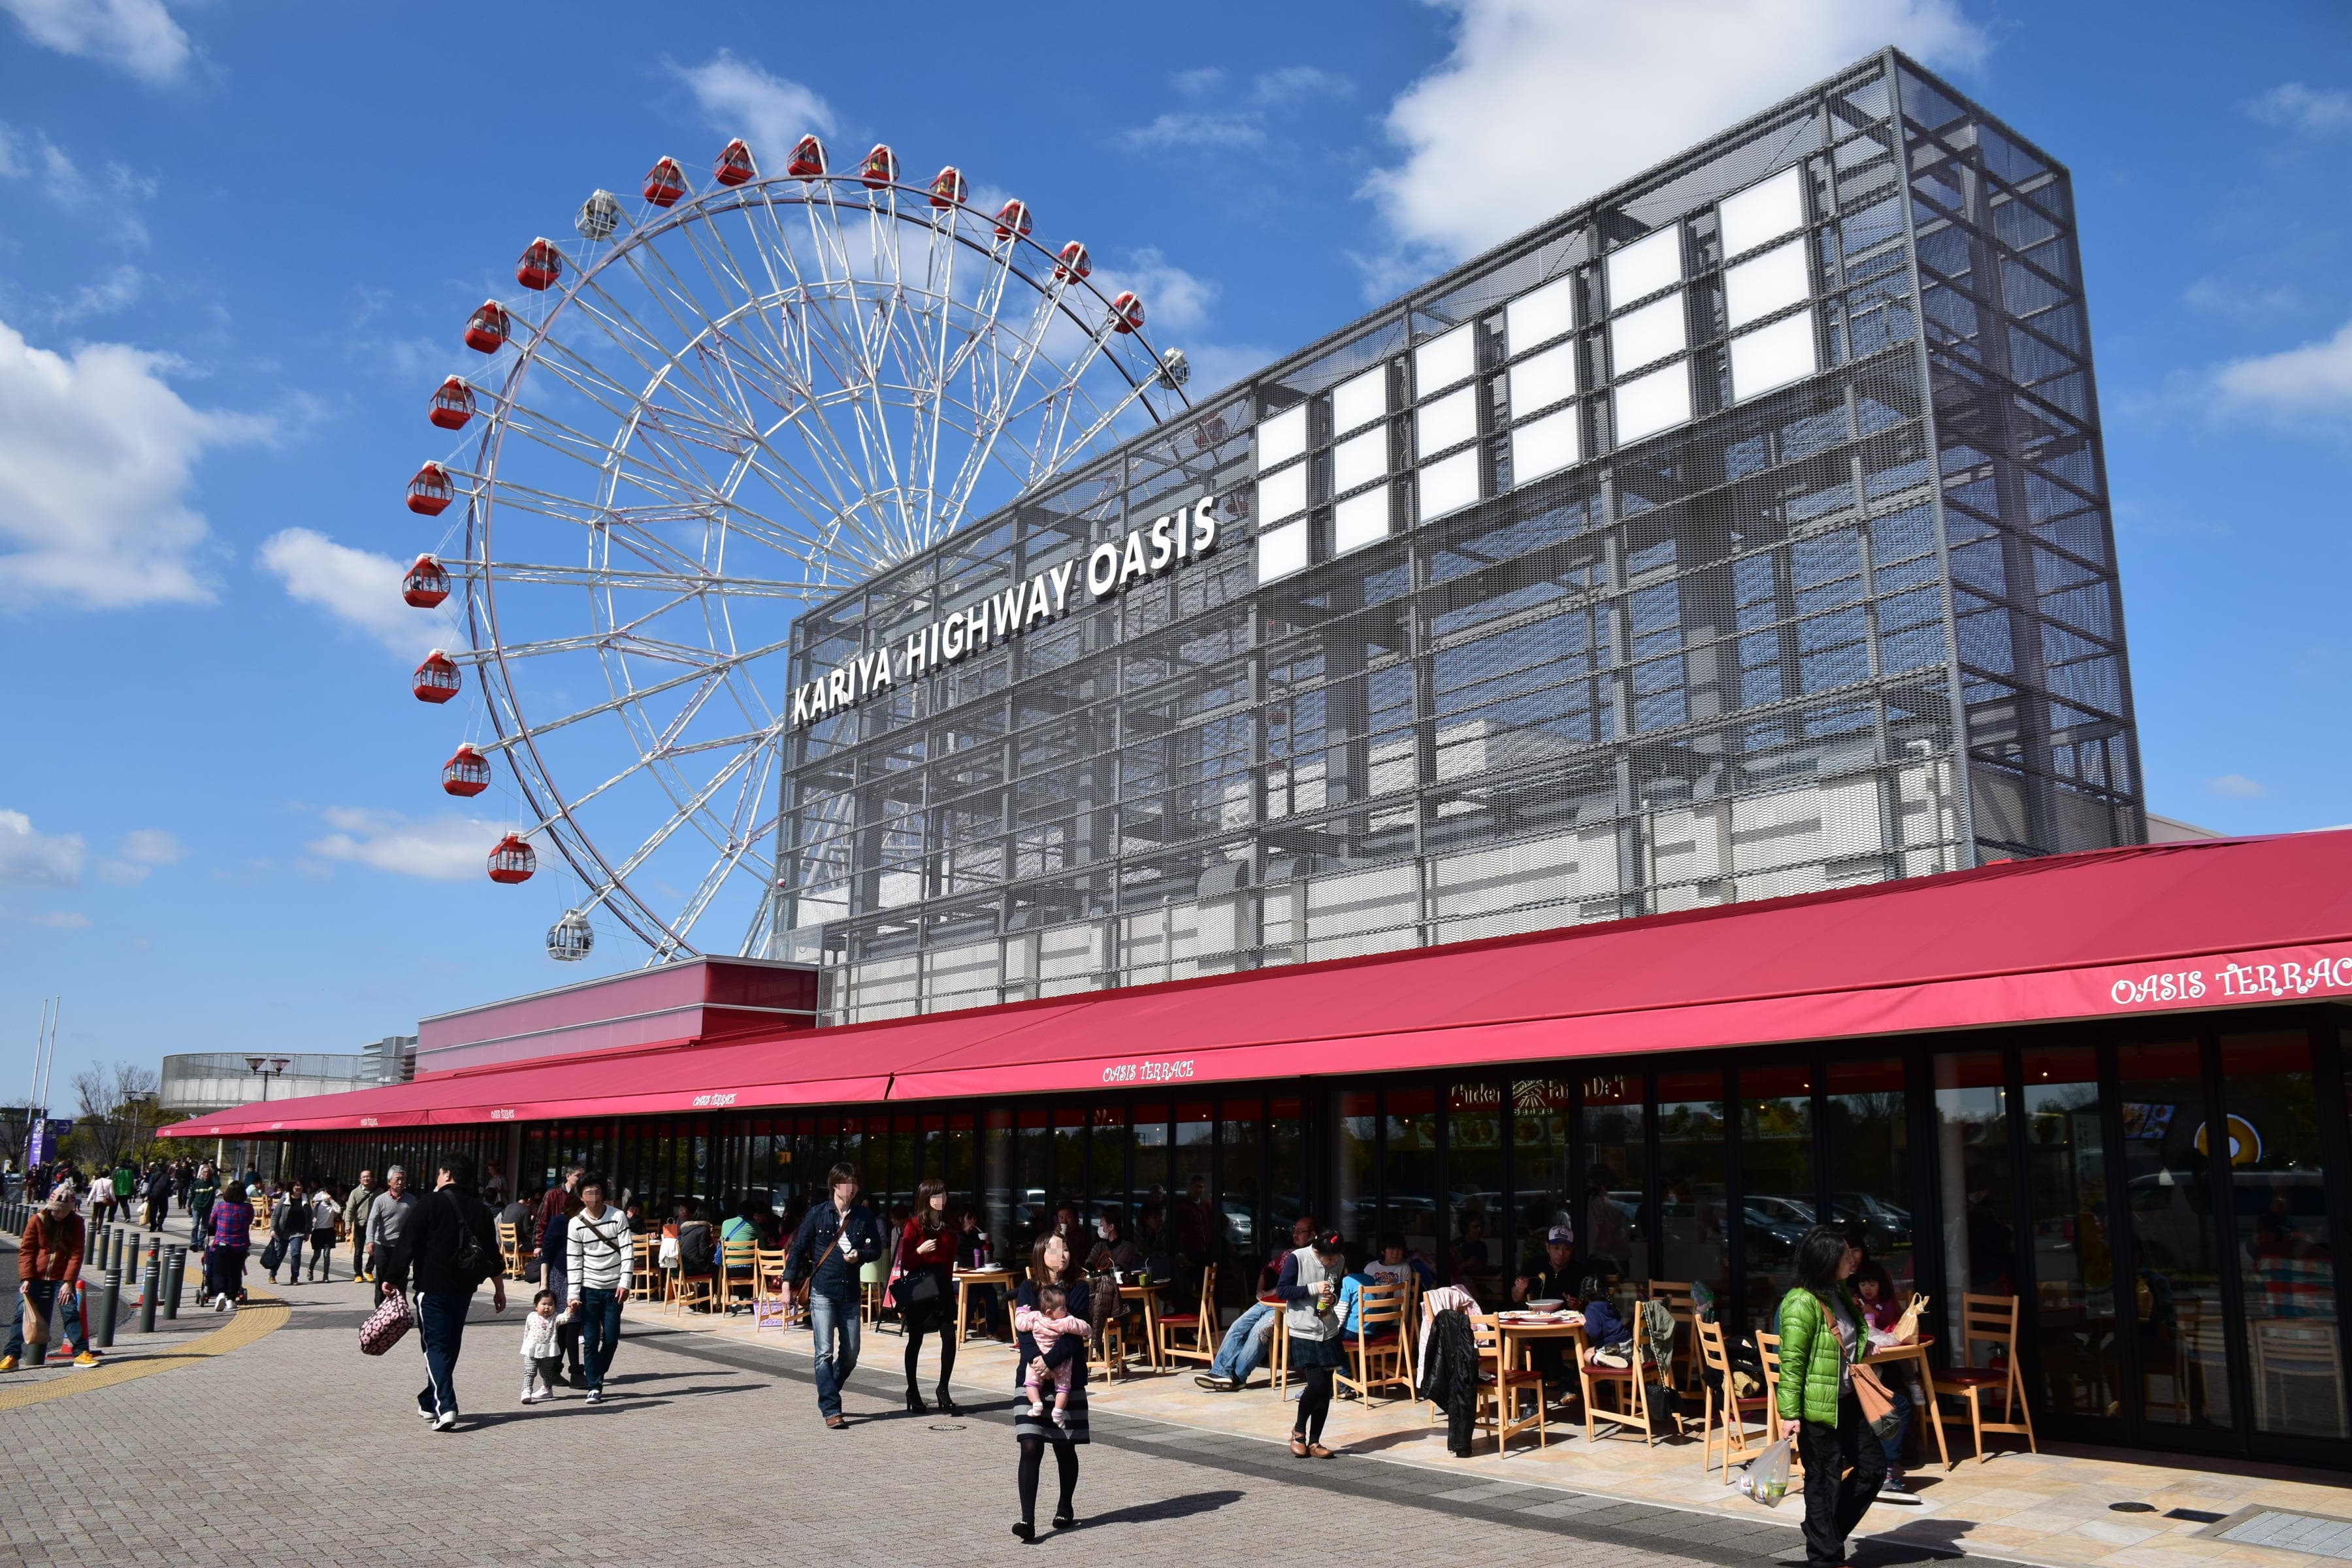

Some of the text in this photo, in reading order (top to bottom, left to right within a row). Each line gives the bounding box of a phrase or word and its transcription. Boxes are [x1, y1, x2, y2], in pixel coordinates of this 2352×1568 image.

[793, 496, 1219, 725] KARIYA HIGHWAY OASIS
[2111, 971, 2206, 1004] OASIS
[1103, 1060, 1194, 1082] OASIS TERRACE
